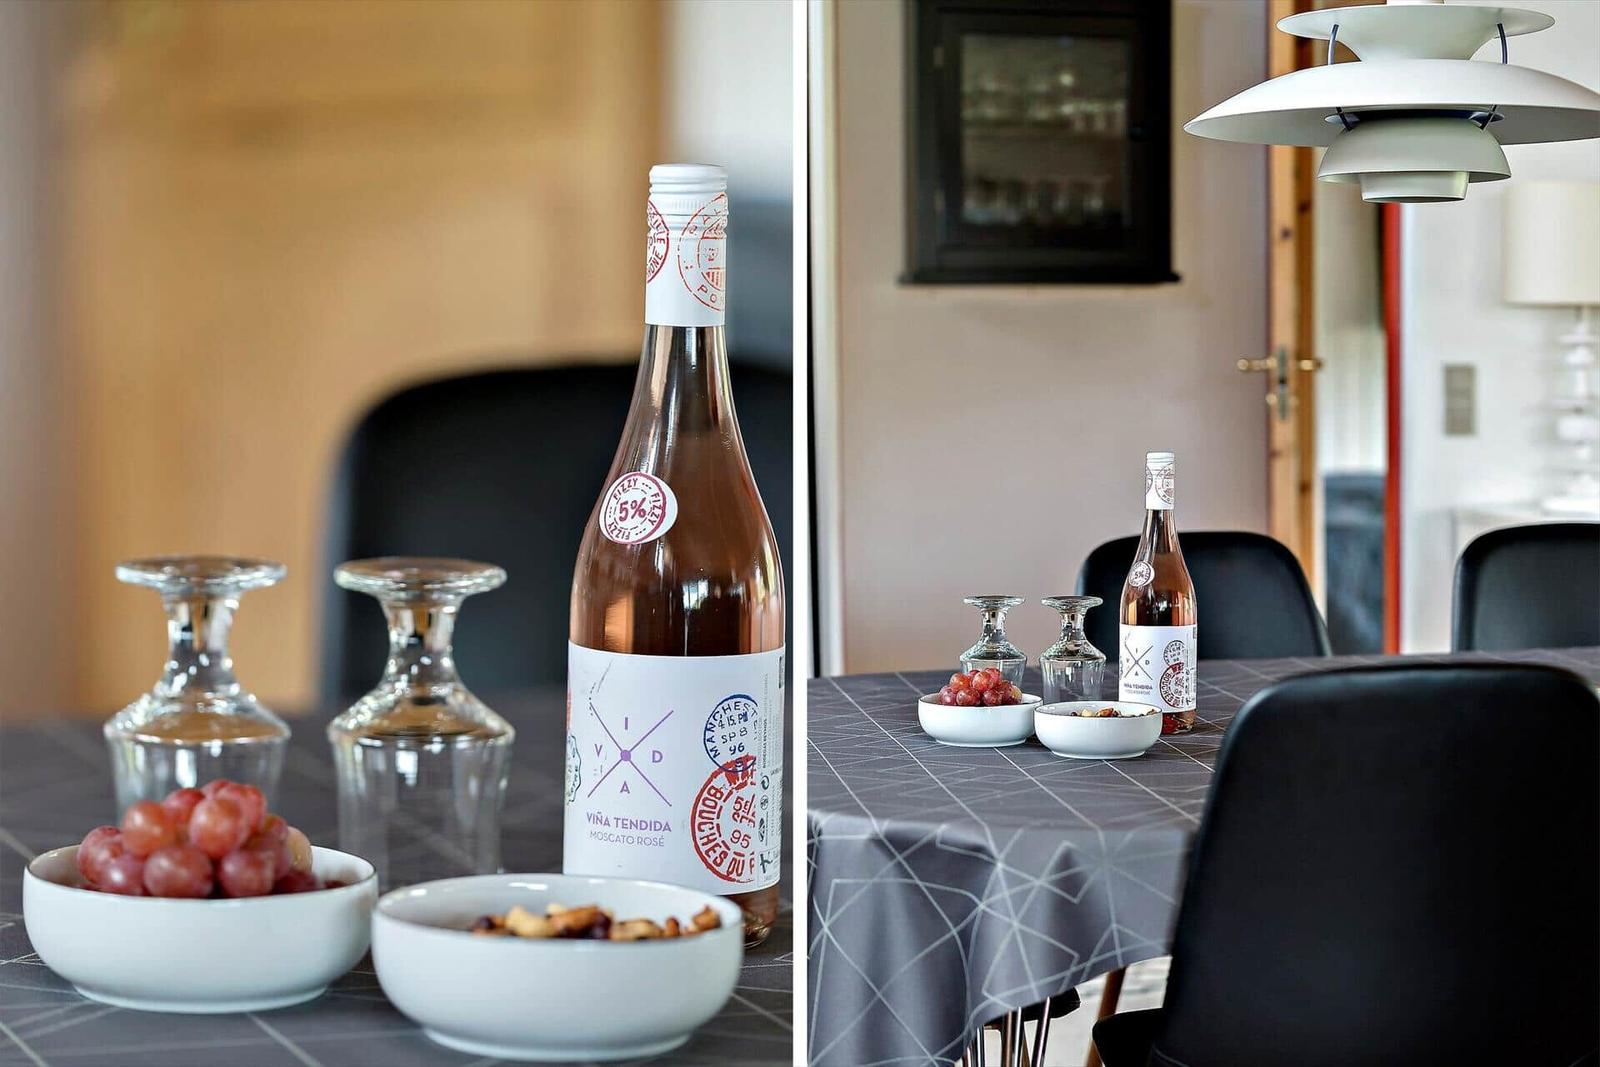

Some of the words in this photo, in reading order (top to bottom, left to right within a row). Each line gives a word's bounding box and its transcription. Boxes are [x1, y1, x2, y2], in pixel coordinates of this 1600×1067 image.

[613, 478, 638, 500] FIZZY
[618, 496, 647, 522] 5%
[647, 492, 662, 526] FIZZY
[608, 522, 631, 540] FIZZY
[586, 811, 611, 827] VIÑA
[614, 817, 672, 832] TENDIDA
[697, 784, 729, 867] BOUCHES
[728, 856, 745, 878] DU
[589, 831, 635, 845] MOSCATO
[636, 835, 665, 847] ROSÉ
[730, 829, 751, 849] 95
